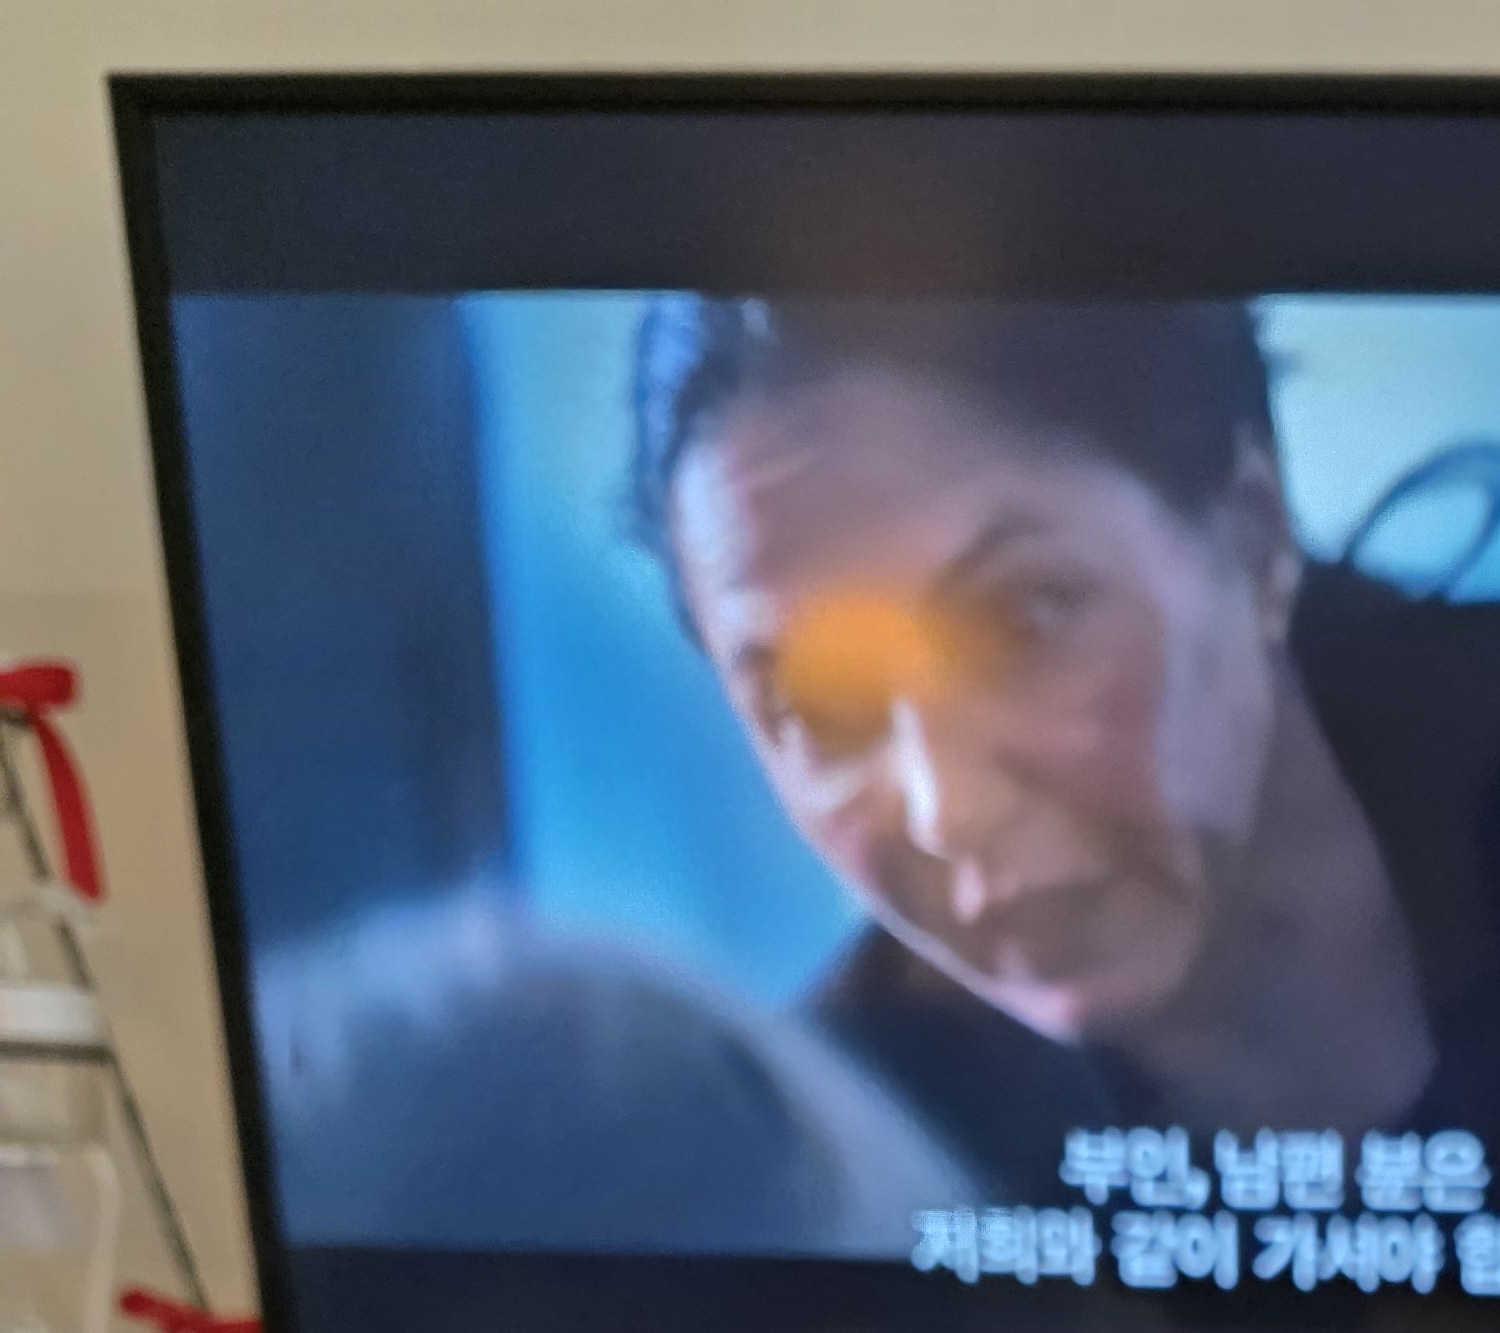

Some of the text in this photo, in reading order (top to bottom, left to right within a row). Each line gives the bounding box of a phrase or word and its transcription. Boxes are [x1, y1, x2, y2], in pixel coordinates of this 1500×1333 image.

[1060, 1126, 1491, 1212] 부인, 남편 분은
[911, 1204, 1101, 1286] 저희와
[1111, 1208, 1239, 1290] 같이
